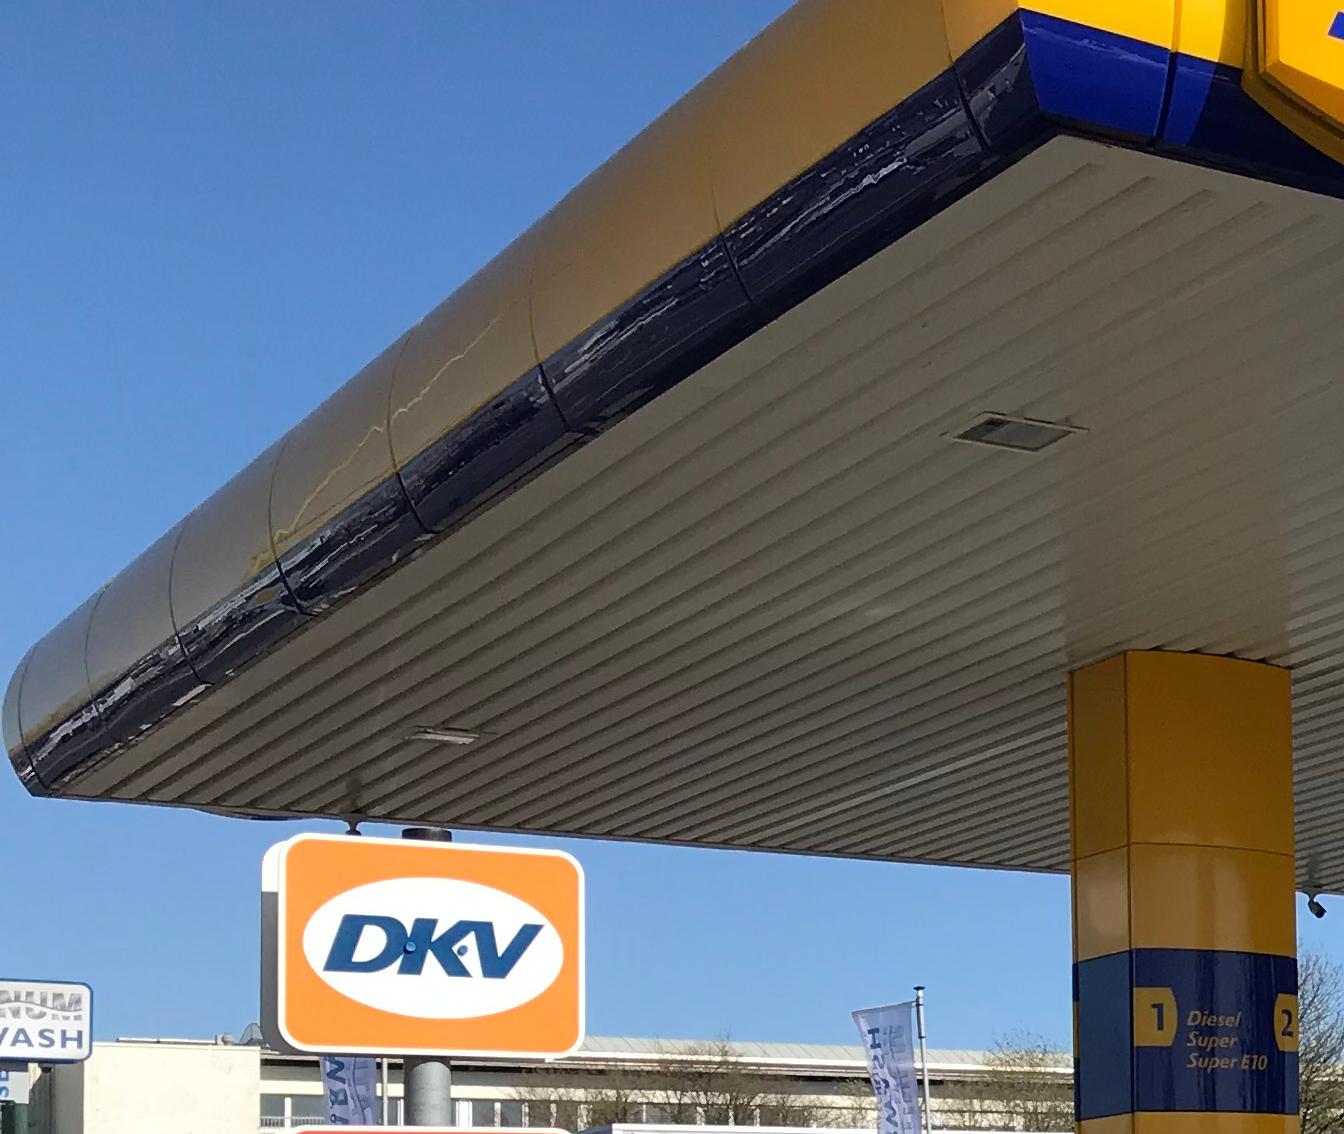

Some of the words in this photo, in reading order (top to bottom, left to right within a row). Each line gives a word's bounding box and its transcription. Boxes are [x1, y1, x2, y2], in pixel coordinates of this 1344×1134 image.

[323, 913, 544, 980] DKV
[1151, 1003, 1165, 1031] 1
[1186, 1010, 1242, 1028] Diesel
[1281, 1009, 1294, 1037] 2
[1186, 1031, 1240, 1052] Super
[1186, 1052, 1239, 1073] Super
[1240, 1053, 1268, 1070] E10
